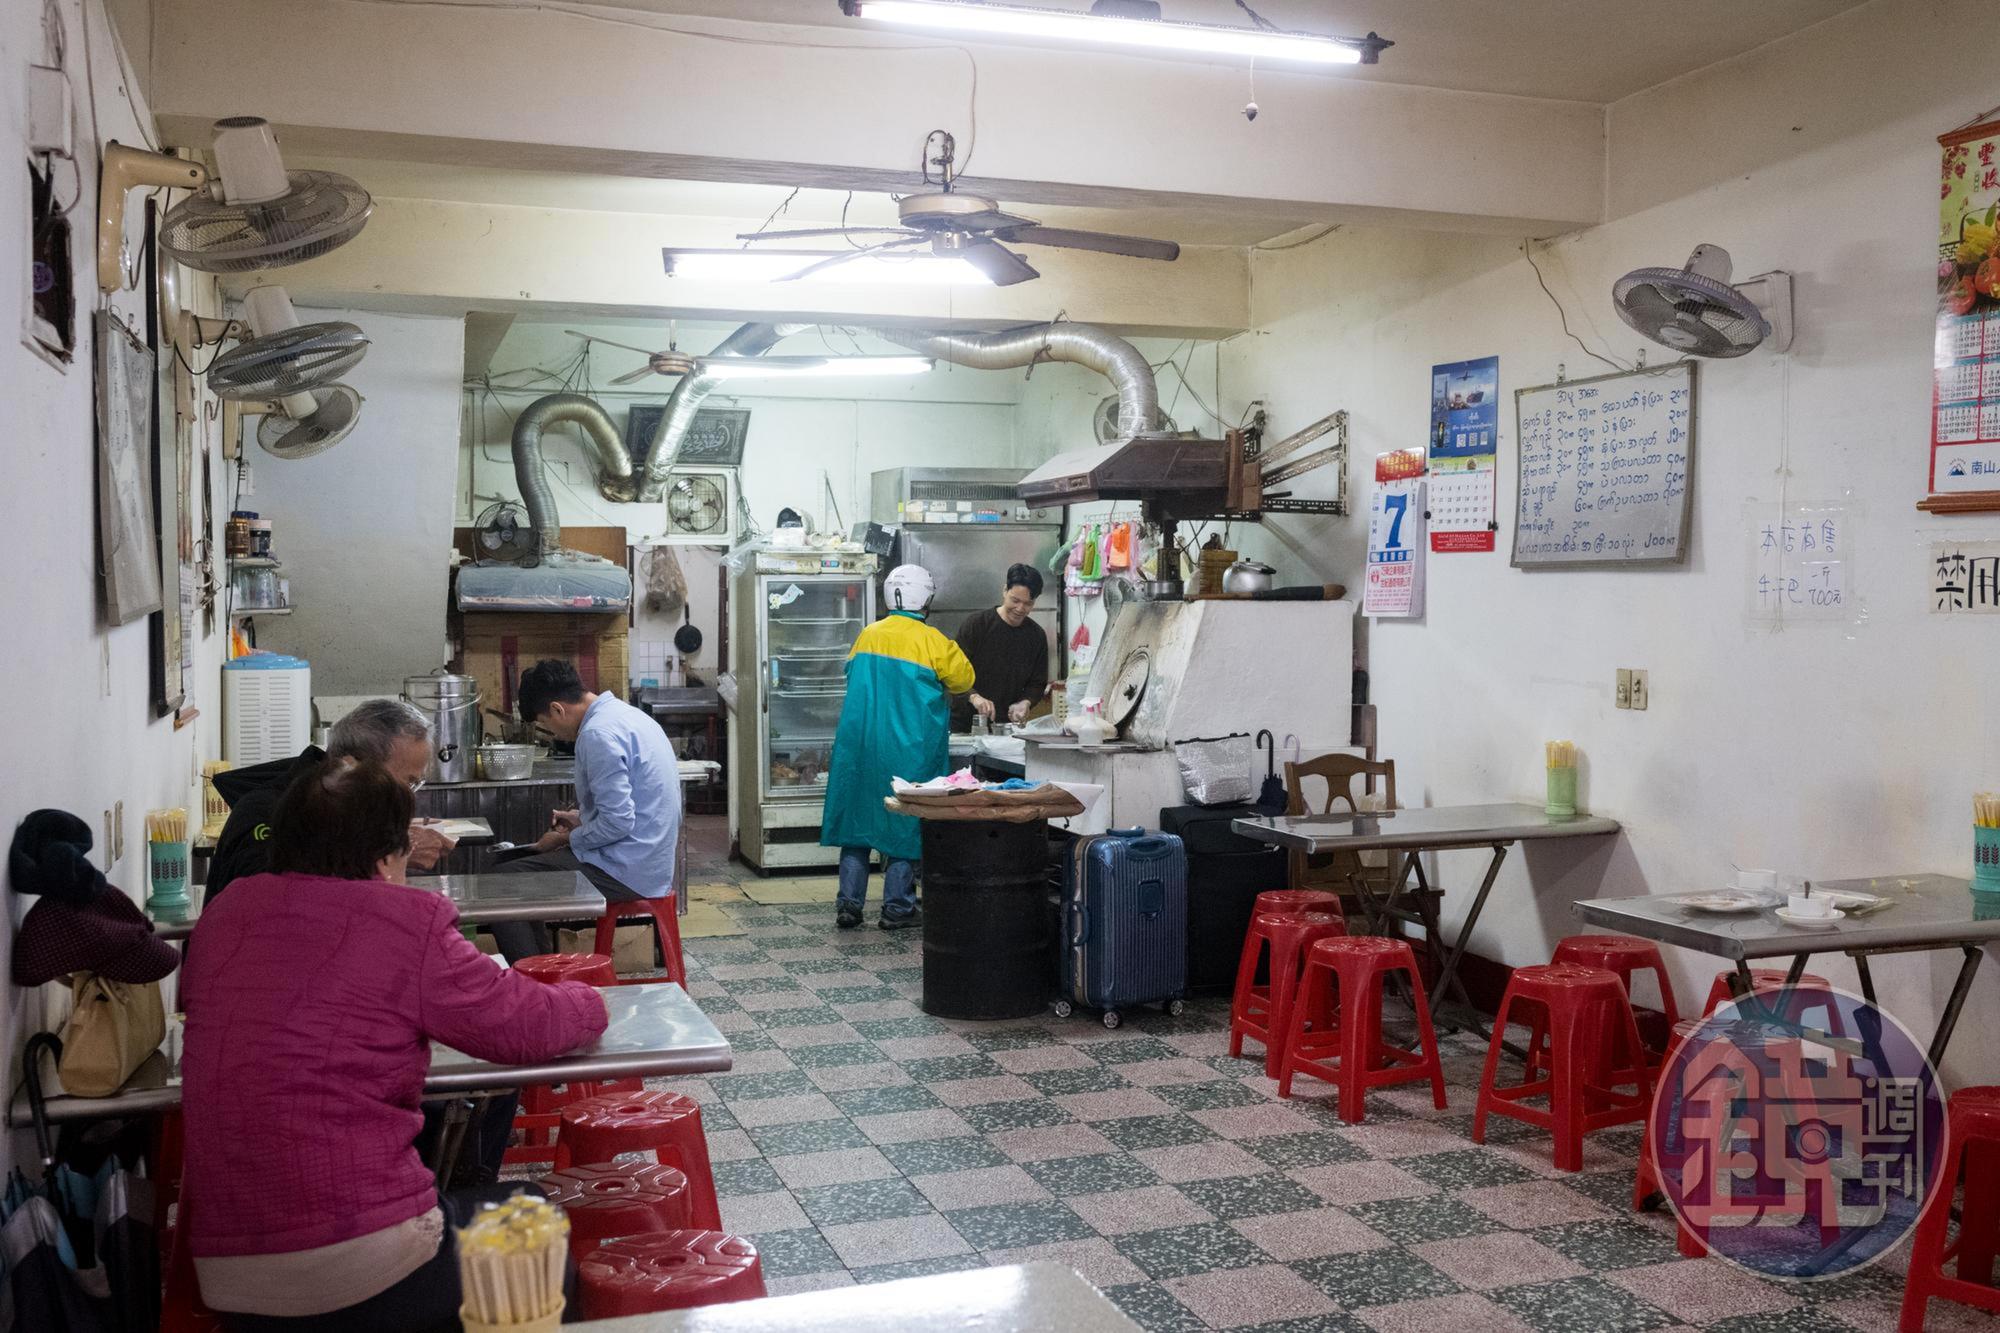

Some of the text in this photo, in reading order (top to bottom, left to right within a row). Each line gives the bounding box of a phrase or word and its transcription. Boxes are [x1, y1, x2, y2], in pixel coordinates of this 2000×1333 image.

[1384, 493, 1407, 548] 7
[1760, 518, 1836, 557] 本店有售
[1935, 545, 2000, 612] 禁用
